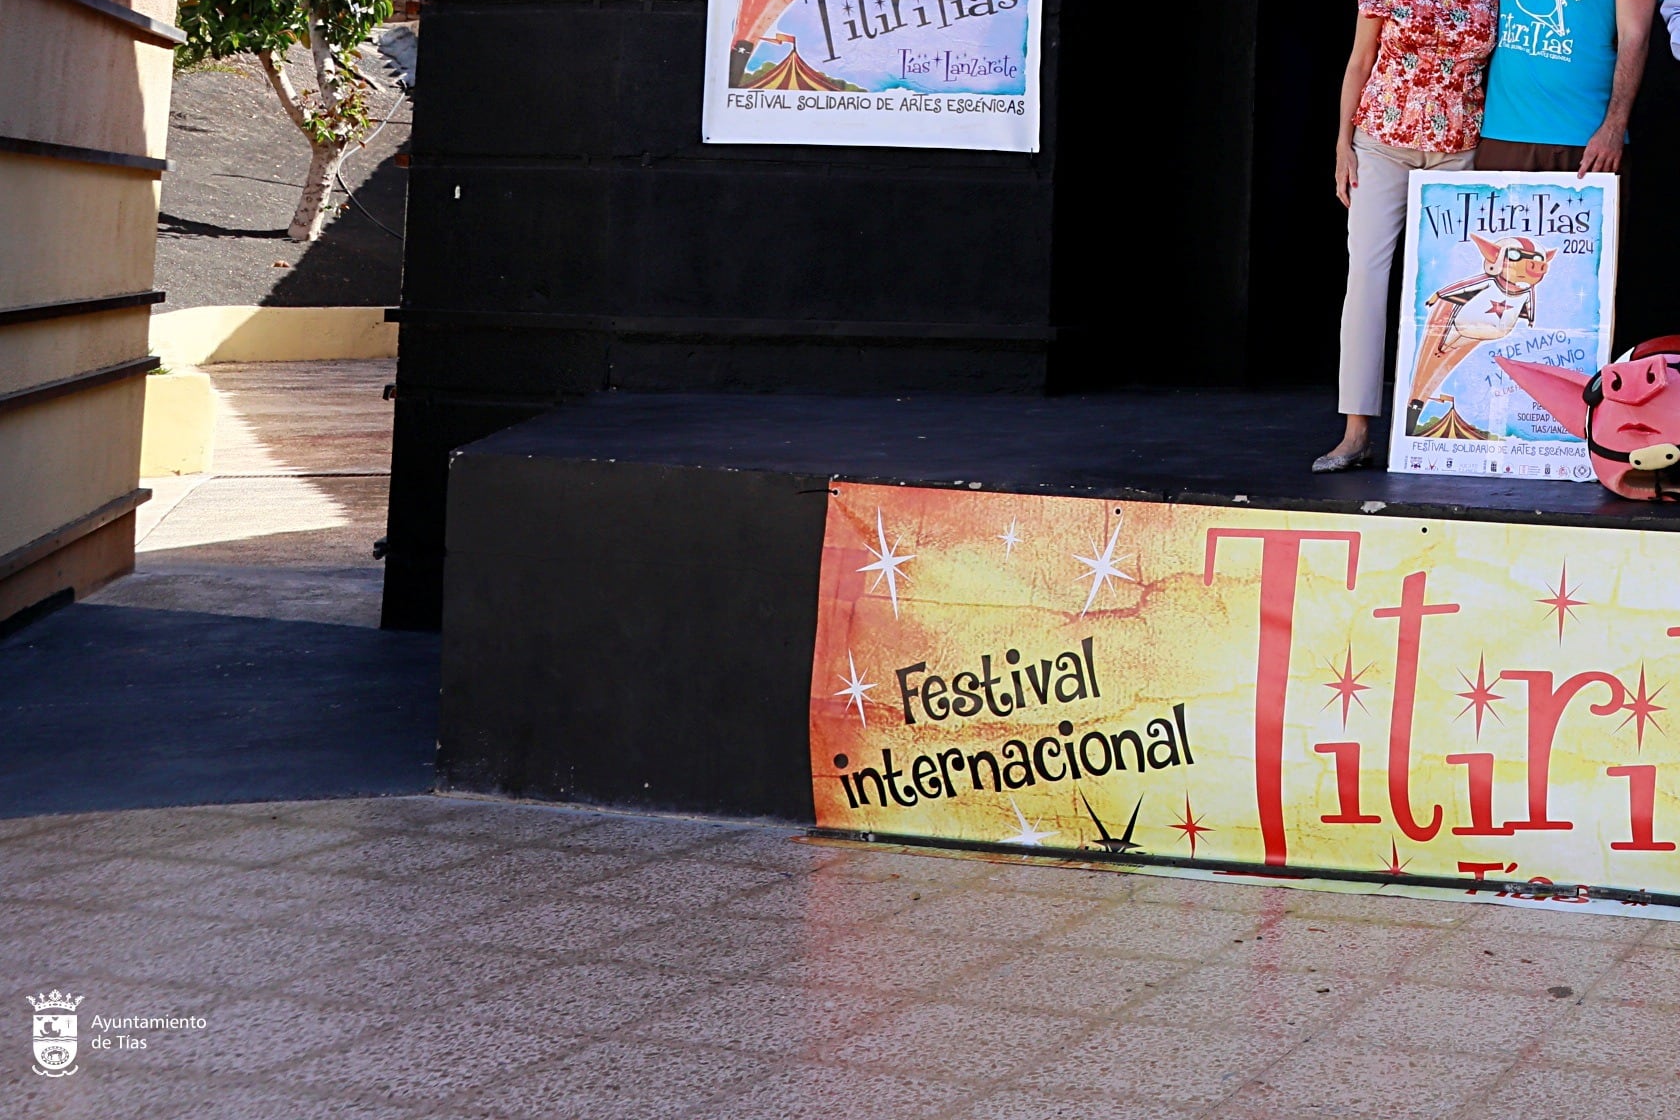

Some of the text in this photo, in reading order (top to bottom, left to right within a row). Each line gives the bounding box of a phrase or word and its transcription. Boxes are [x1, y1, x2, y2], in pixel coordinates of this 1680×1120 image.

[944, 50, 1017, 82] Lanzarote
[876, 96, 894, 111] DE
[900, 93, 942, 114] ARTES
[1424, 204, 1454, 239] VII
[1563, 239, 1594, 255] 2024
[1506, 343, 1522, 359] DE
[1497, 445, 1508, 454] DE
[1510, 443, 1537, 456] ARTES
[895, 636, 1101, 725] Festival
[833, 702, 1195, 809] internacional
